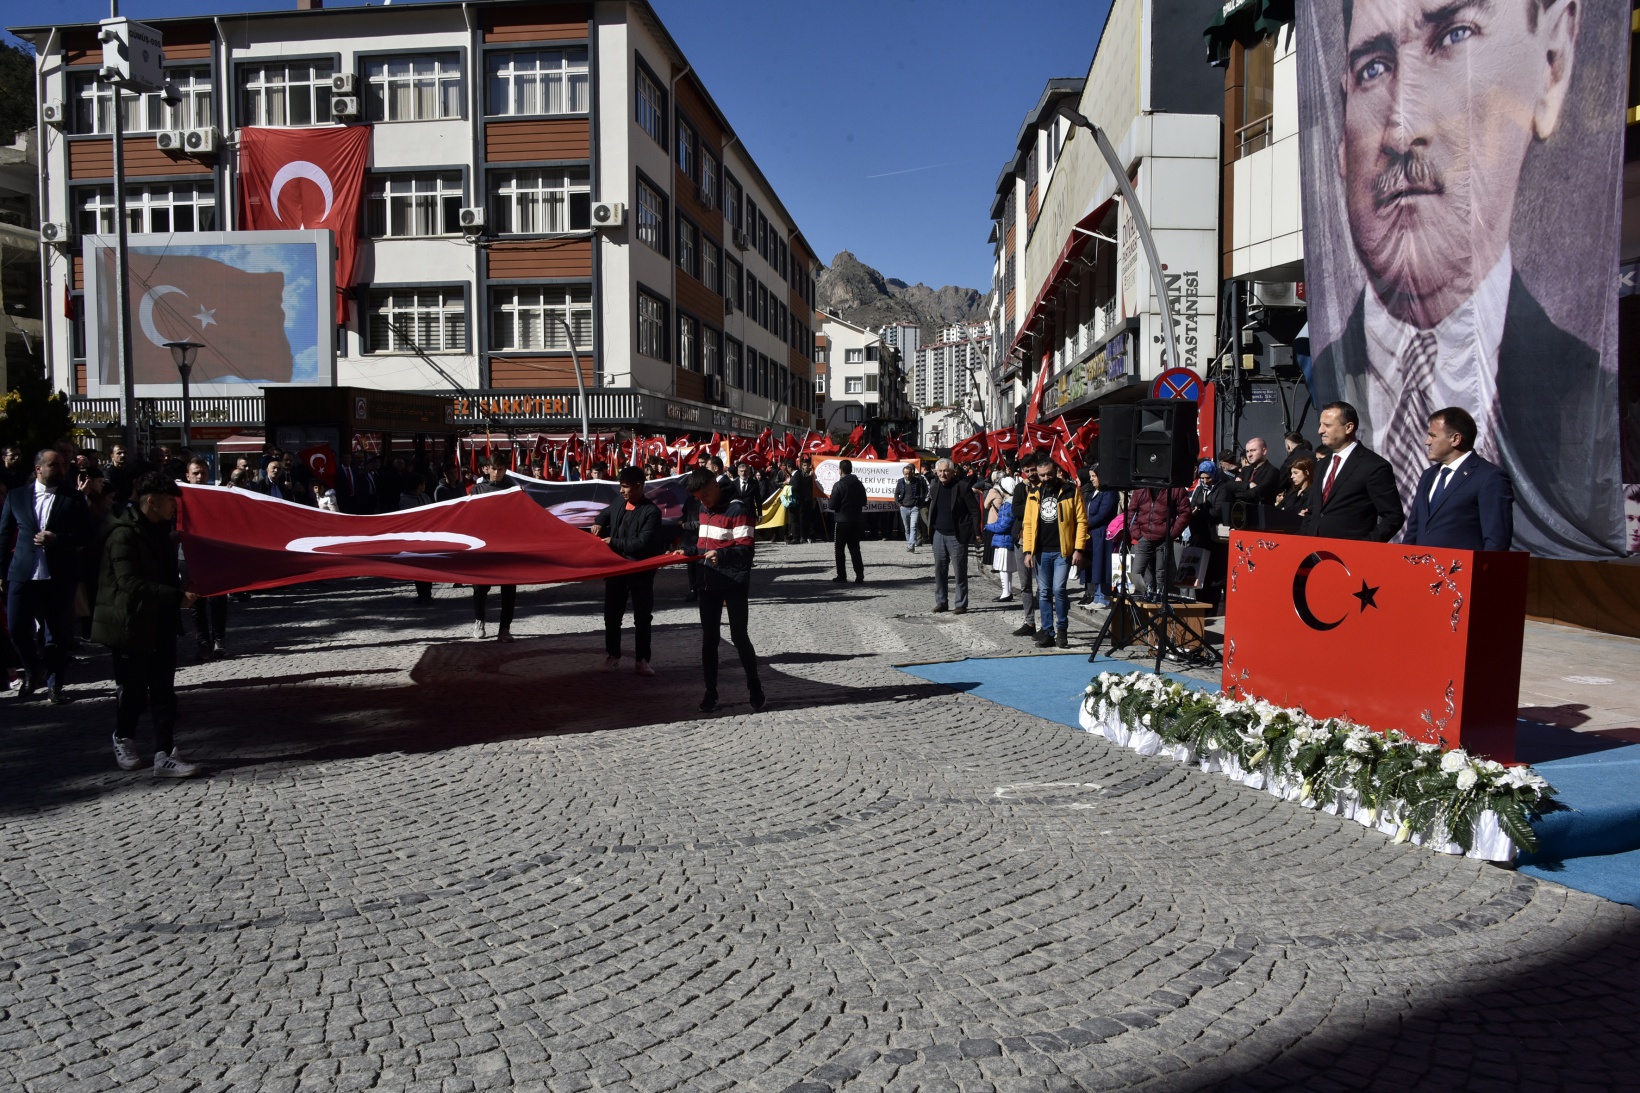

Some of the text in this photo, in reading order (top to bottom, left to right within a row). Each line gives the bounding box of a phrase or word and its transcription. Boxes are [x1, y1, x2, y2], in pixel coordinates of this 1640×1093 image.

[1183, 270, 1199, 369] PASTANESİ
[454, 400, 469, 415] EZ
[852, 466, 890, 475] ÜMÜŞHANE
